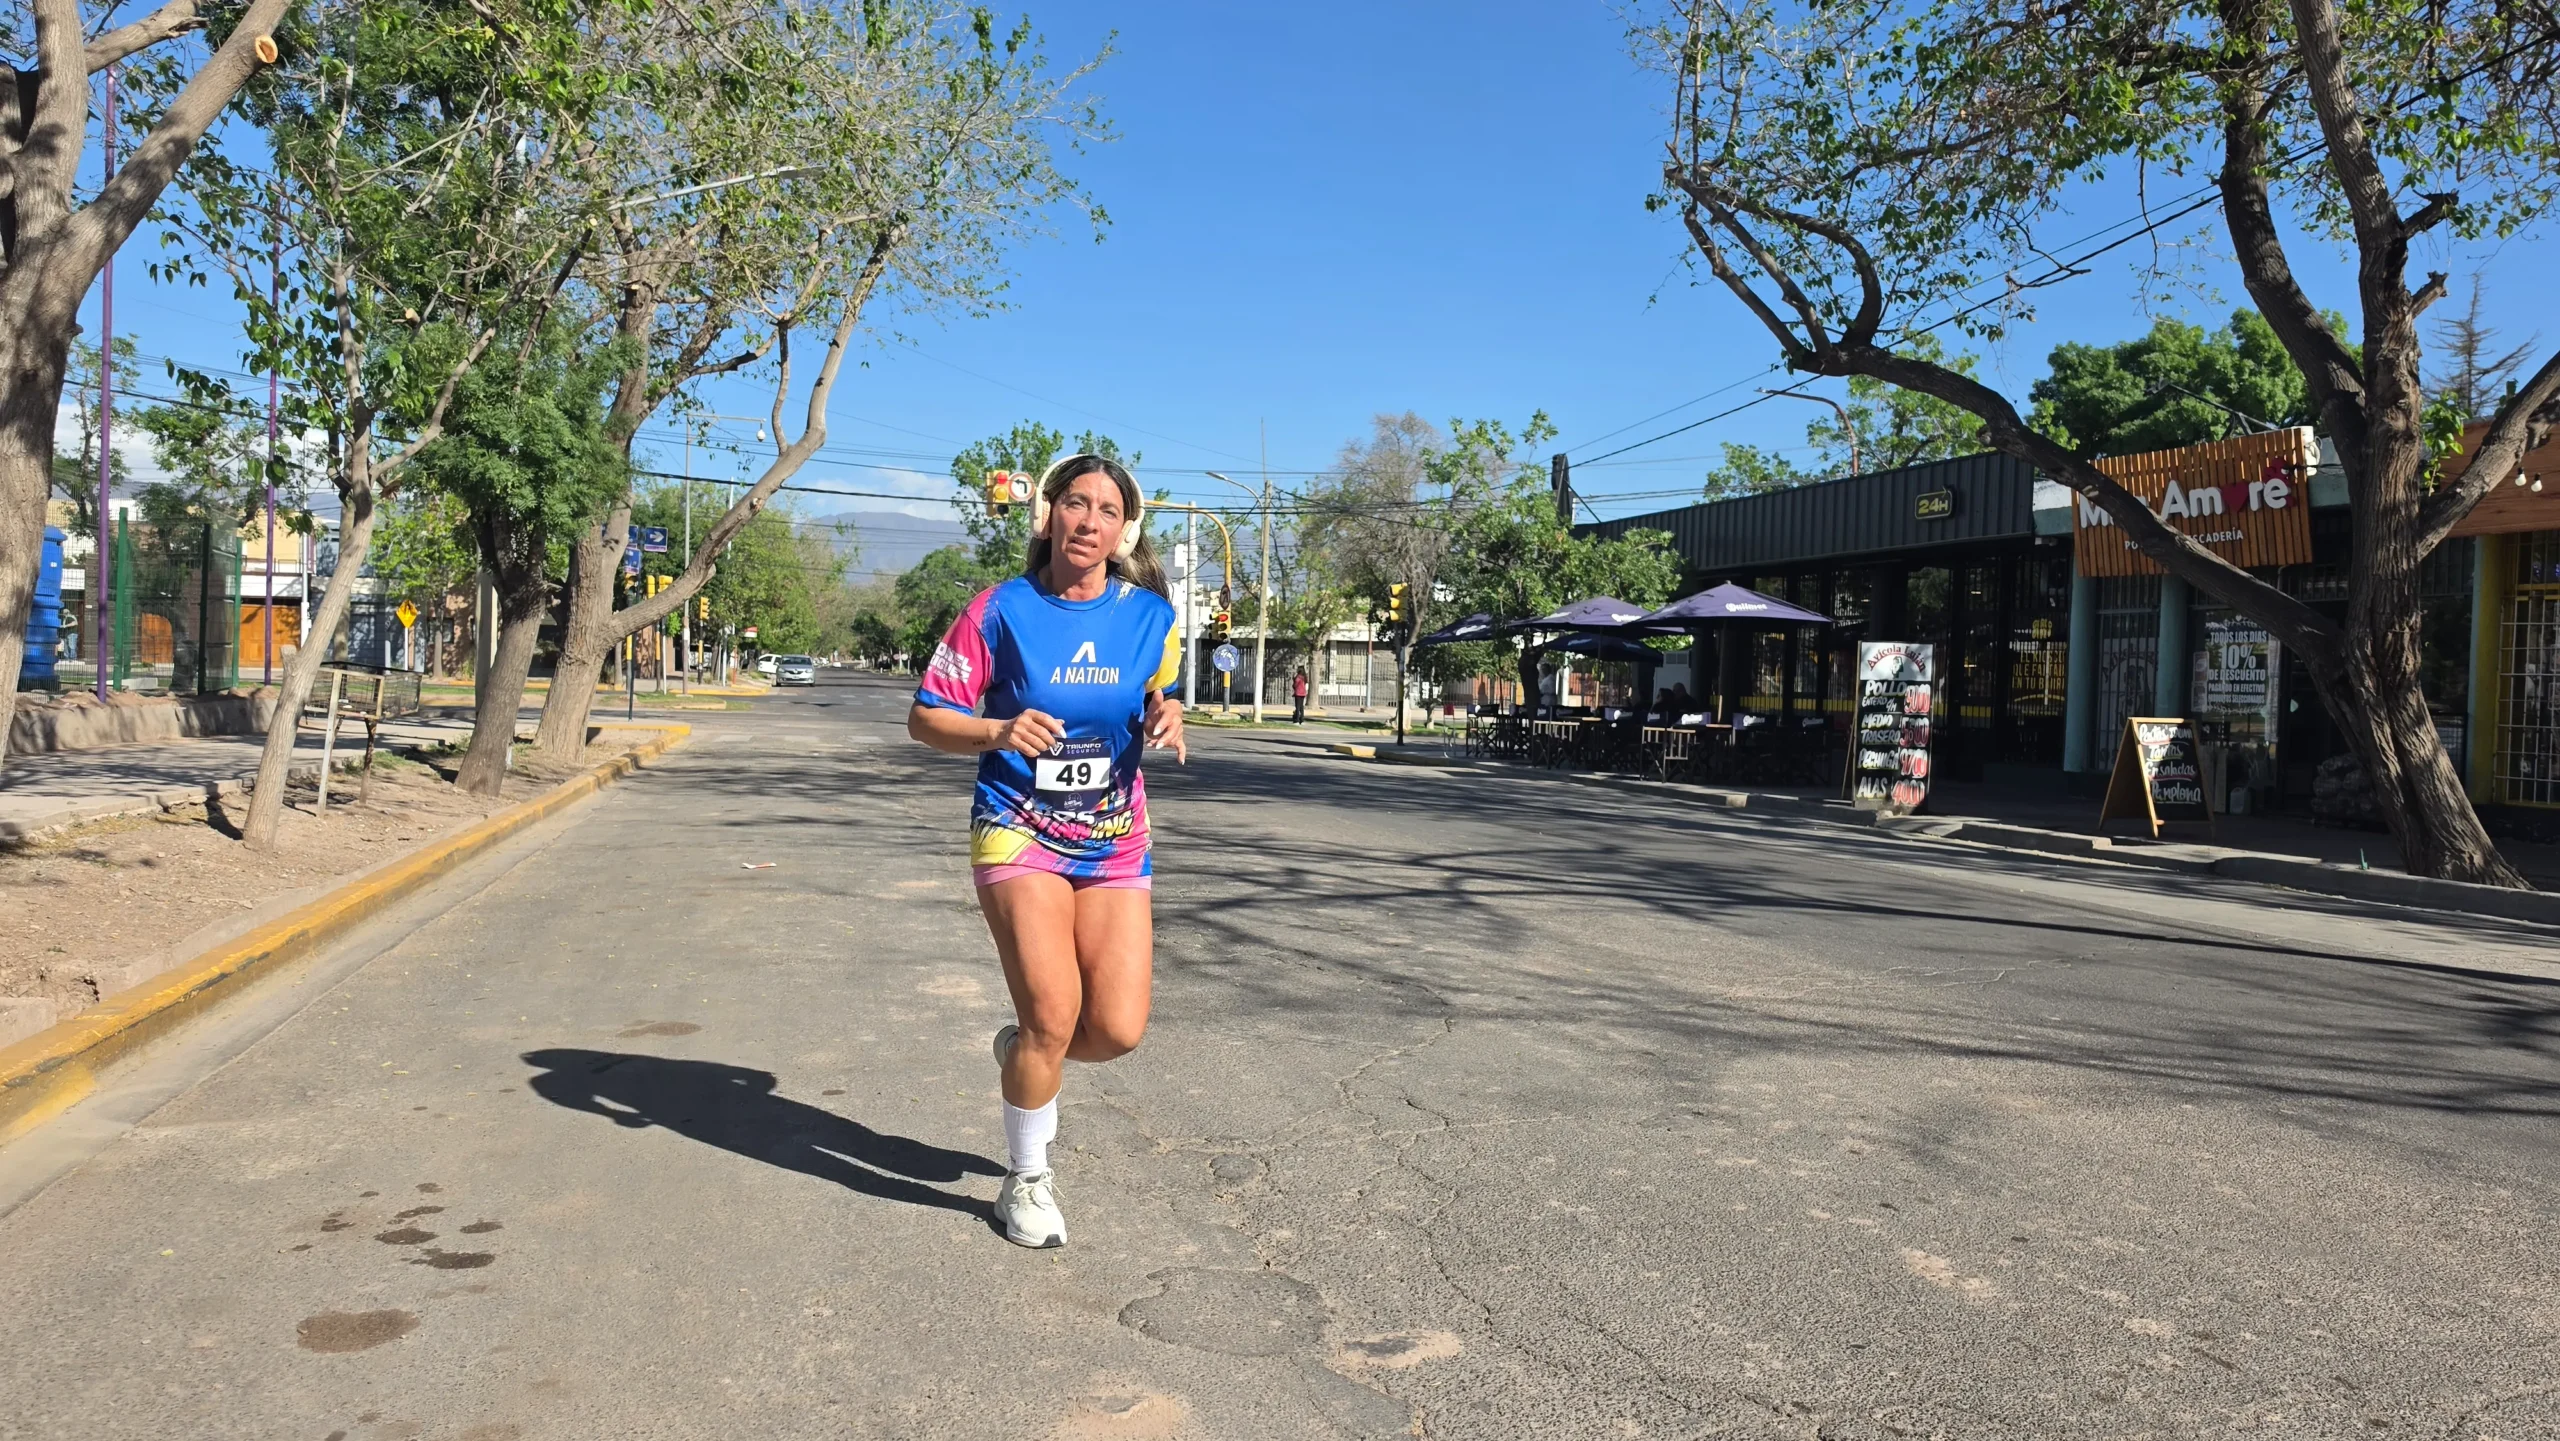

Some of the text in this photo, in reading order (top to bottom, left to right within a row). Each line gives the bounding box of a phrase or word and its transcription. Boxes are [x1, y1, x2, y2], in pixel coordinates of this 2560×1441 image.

[1918, 498, 1949, 514] 24H
[2186, 527, 2244, 544] SCADERÍA
[2210, 631, 2234, 645] TODOS
[2235, 631, 2249, 643] LOS
[935, 641, 973, 673] ONEL
[2219, 643, 2257, 669] 10%
[1050, 667, 1119, 684] A NATION
[2208, 669, 2266, 681] DE DESCUENTO
[1866, 680, 1908, 697] POLLO
[1862, 714, 1893, 729] MEDIO
[1860, 729, 1901, 745] TRASERO
[1056, 762, 1092, 786] 49
[1856, 776, 1888, 798] ALAS
